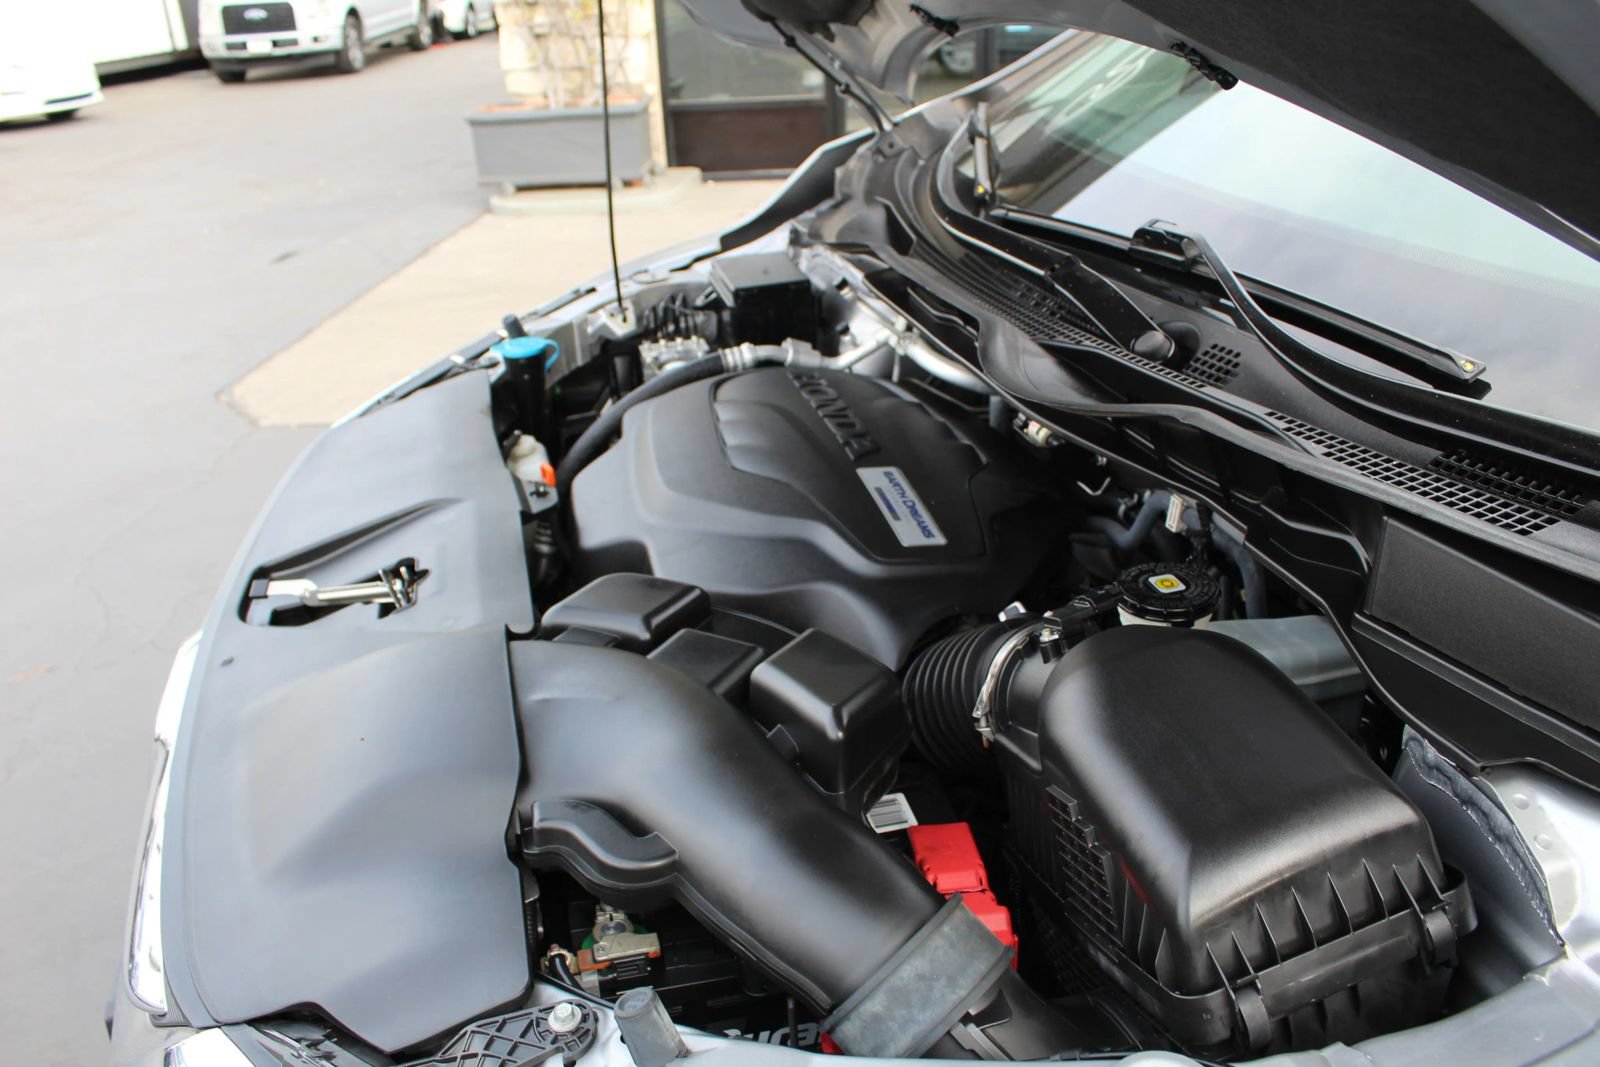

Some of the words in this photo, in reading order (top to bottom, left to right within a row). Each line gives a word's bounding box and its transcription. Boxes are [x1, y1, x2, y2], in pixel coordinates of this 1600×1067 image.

[787, 371, 880, 461] HONDA
[883, 470, 908, 501] EARTH
[903, 498, 936, 539] DREAMS
